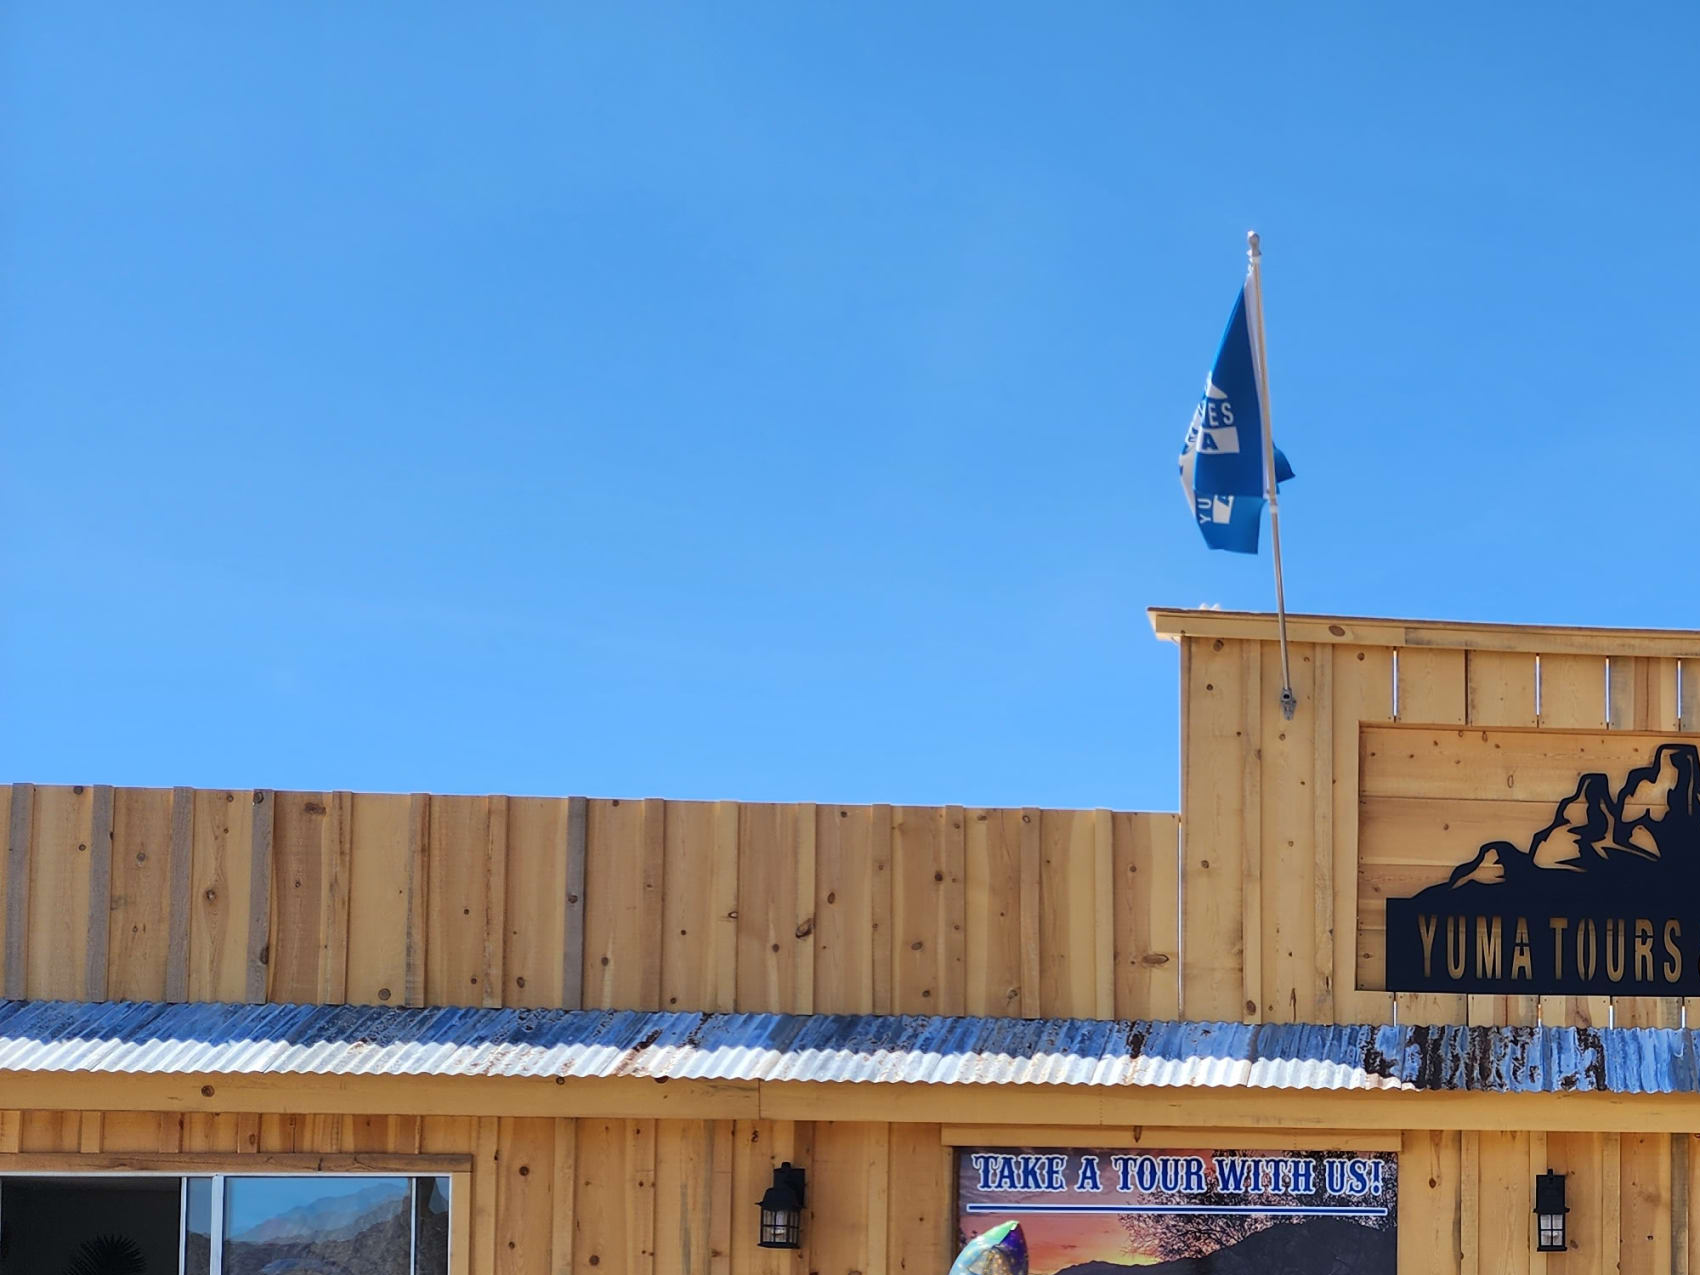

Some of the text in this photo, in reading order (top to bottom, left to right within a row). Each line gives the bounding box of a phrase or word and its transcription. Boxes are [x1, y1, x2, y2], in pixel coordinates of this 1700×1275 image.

[1417, 914, 1533, 981] YUMA
[1549, 917, 1683, 984] TOURS
[972, 1153, 1384, 1196] TAKE A TOUR WITH US!
